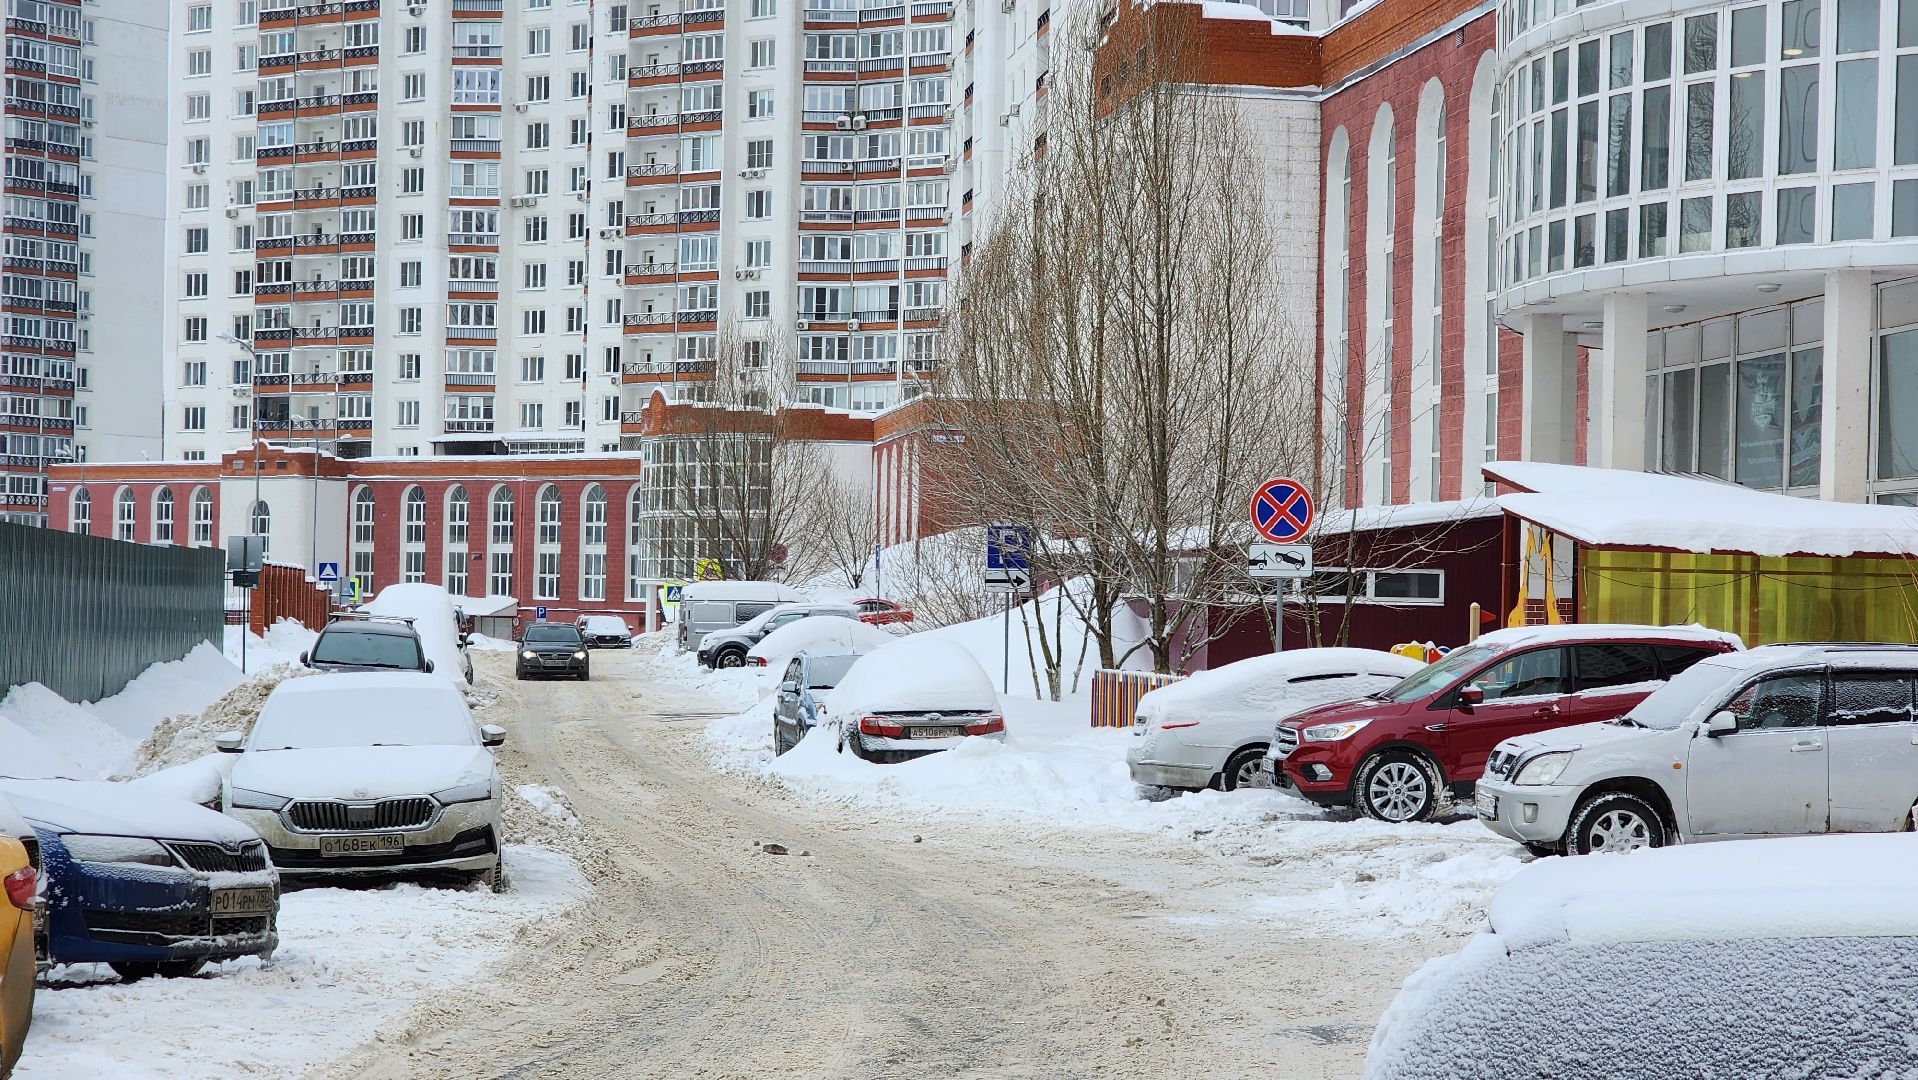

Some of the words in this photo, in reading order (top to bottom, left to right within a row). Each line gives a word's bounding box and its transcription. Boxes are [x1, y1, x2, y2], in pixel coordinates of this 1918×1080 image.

[999, 529, 1023, 565] P
[538, 607, 545, 618] P
[380, 836, 400, 847] 196
